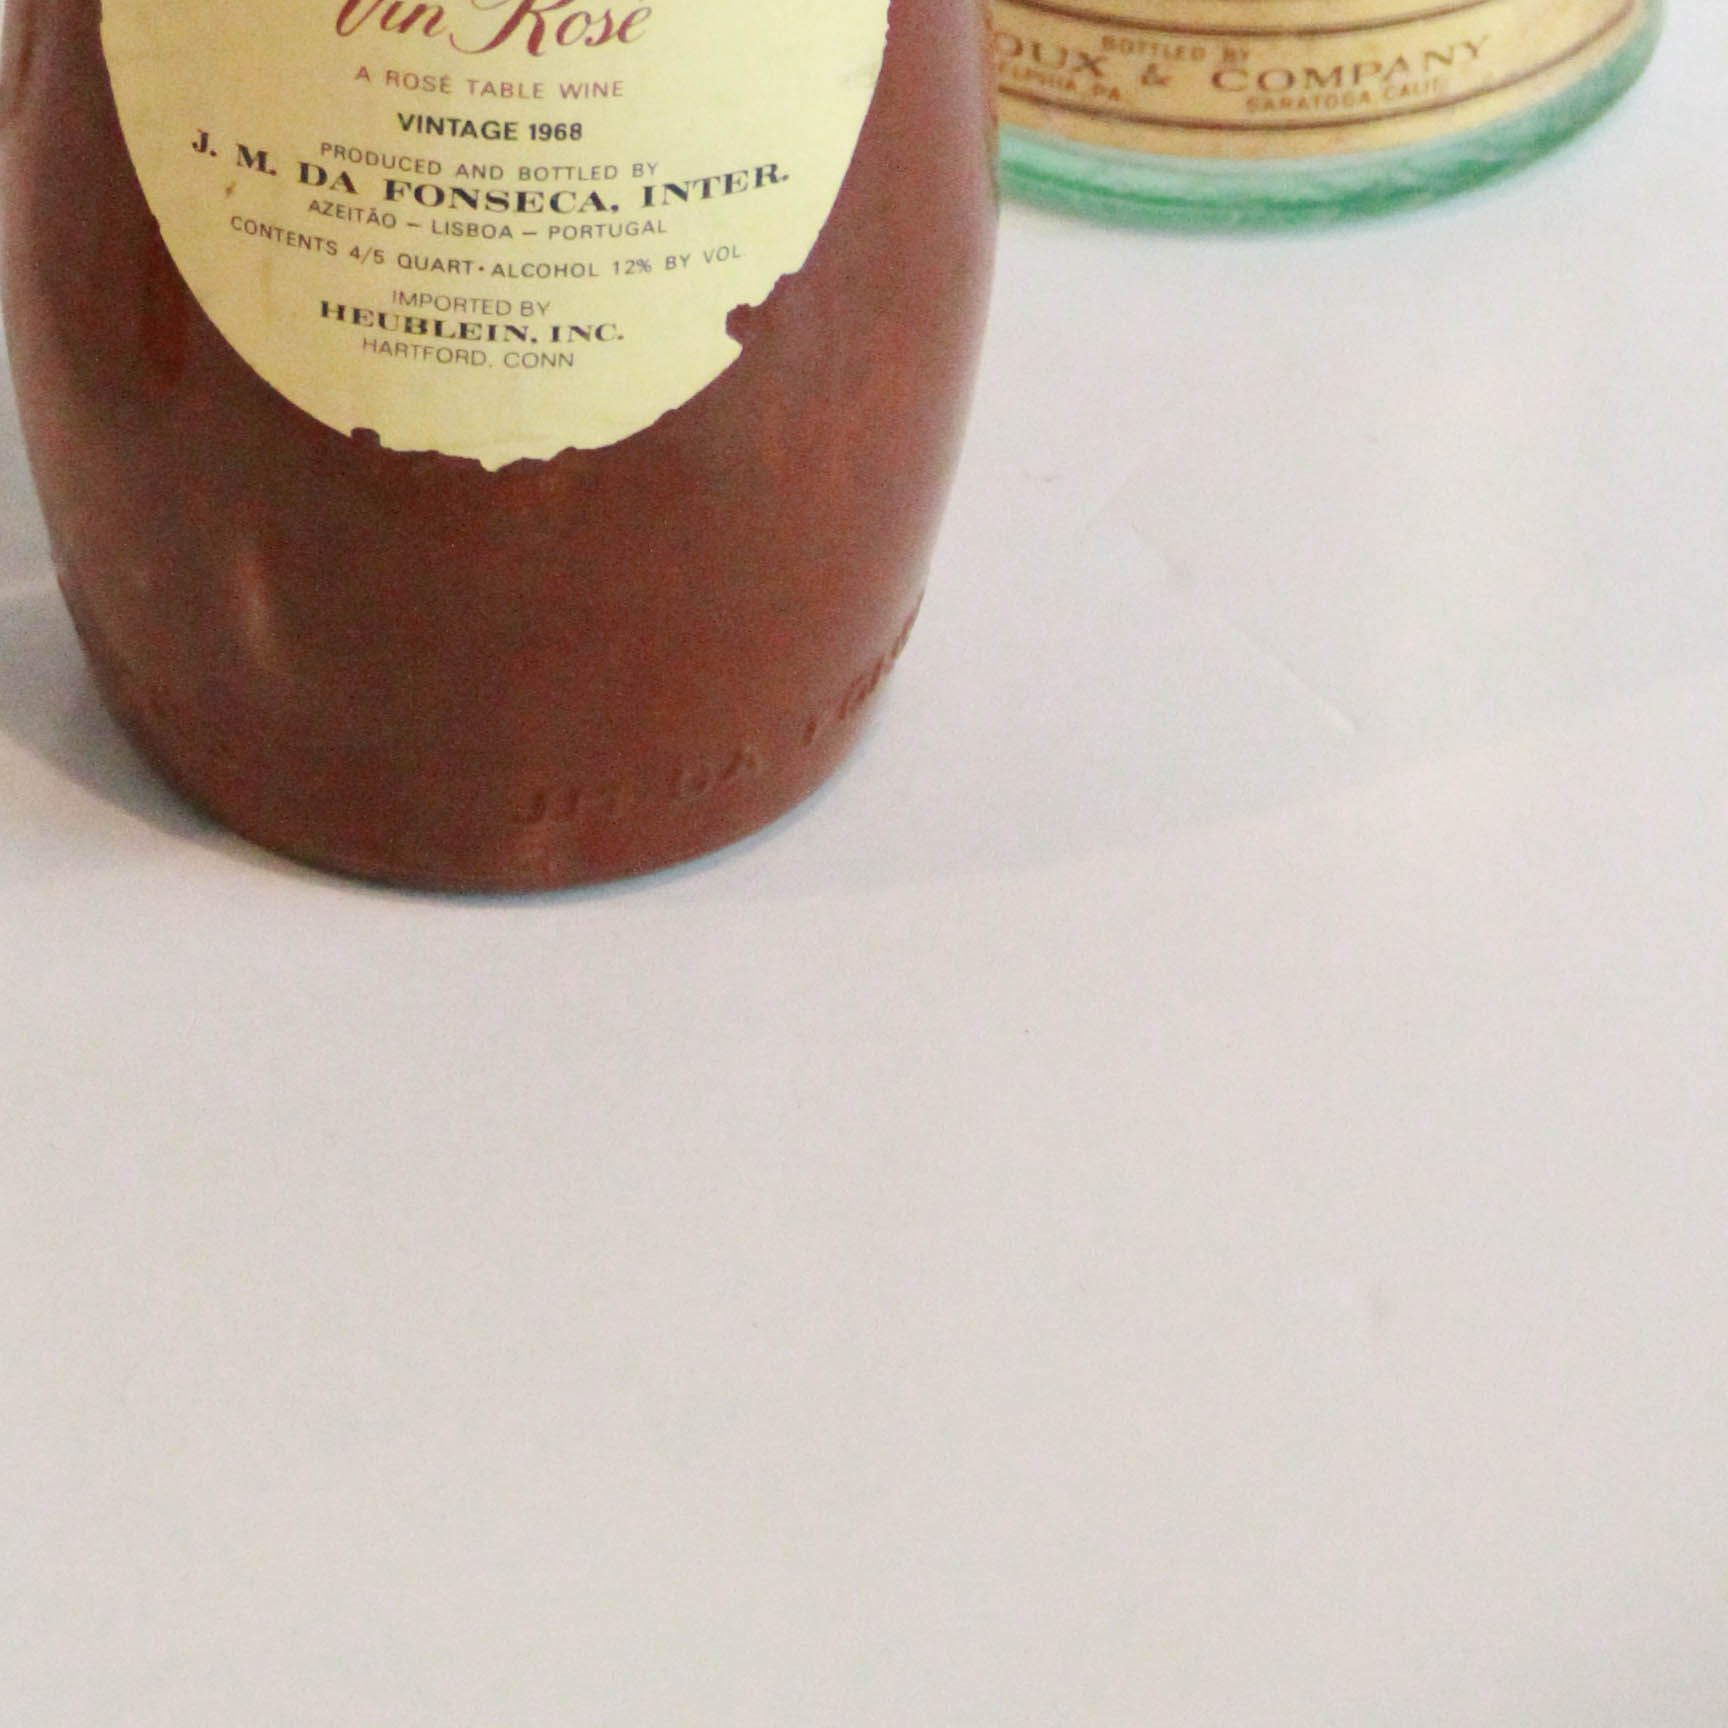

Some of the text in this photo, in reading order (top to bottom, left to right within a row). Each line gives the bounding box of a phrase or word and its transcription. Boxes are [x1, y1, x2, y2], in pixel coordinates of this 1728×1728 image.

[1101, 35, 1206, 62] BOTTLED
[1140, 62, 1171, 85] &
[1211, 34, 1491, 93] COMPANY
[355, 66, 625, 100] A ROSÉ TABLE WINE
[397, 112, 584, 143] VINTAGE 1968
[191, 128, 791, 215] J. M. DA FONSECA, INTER.
[320, 141, 661, 182] PRODUCED AND BOTTLED BY
[431, 218, 514, 240] LISBOA
[548, 218, 668, 241] PORTUGAL
[230, 214, 339, 256] CONTENTS
[349, 244, 387, 265] 4/5
[491, 260, 600, 280] ALCOHOL
[612, 258, 653, 278] 12%
[664, 251, 692, 272] BY
[391, 288, 551, 318] IMPORTED BY
[550, 322, 625, 343] INC.
[503, 349, 576, 370] CONN
